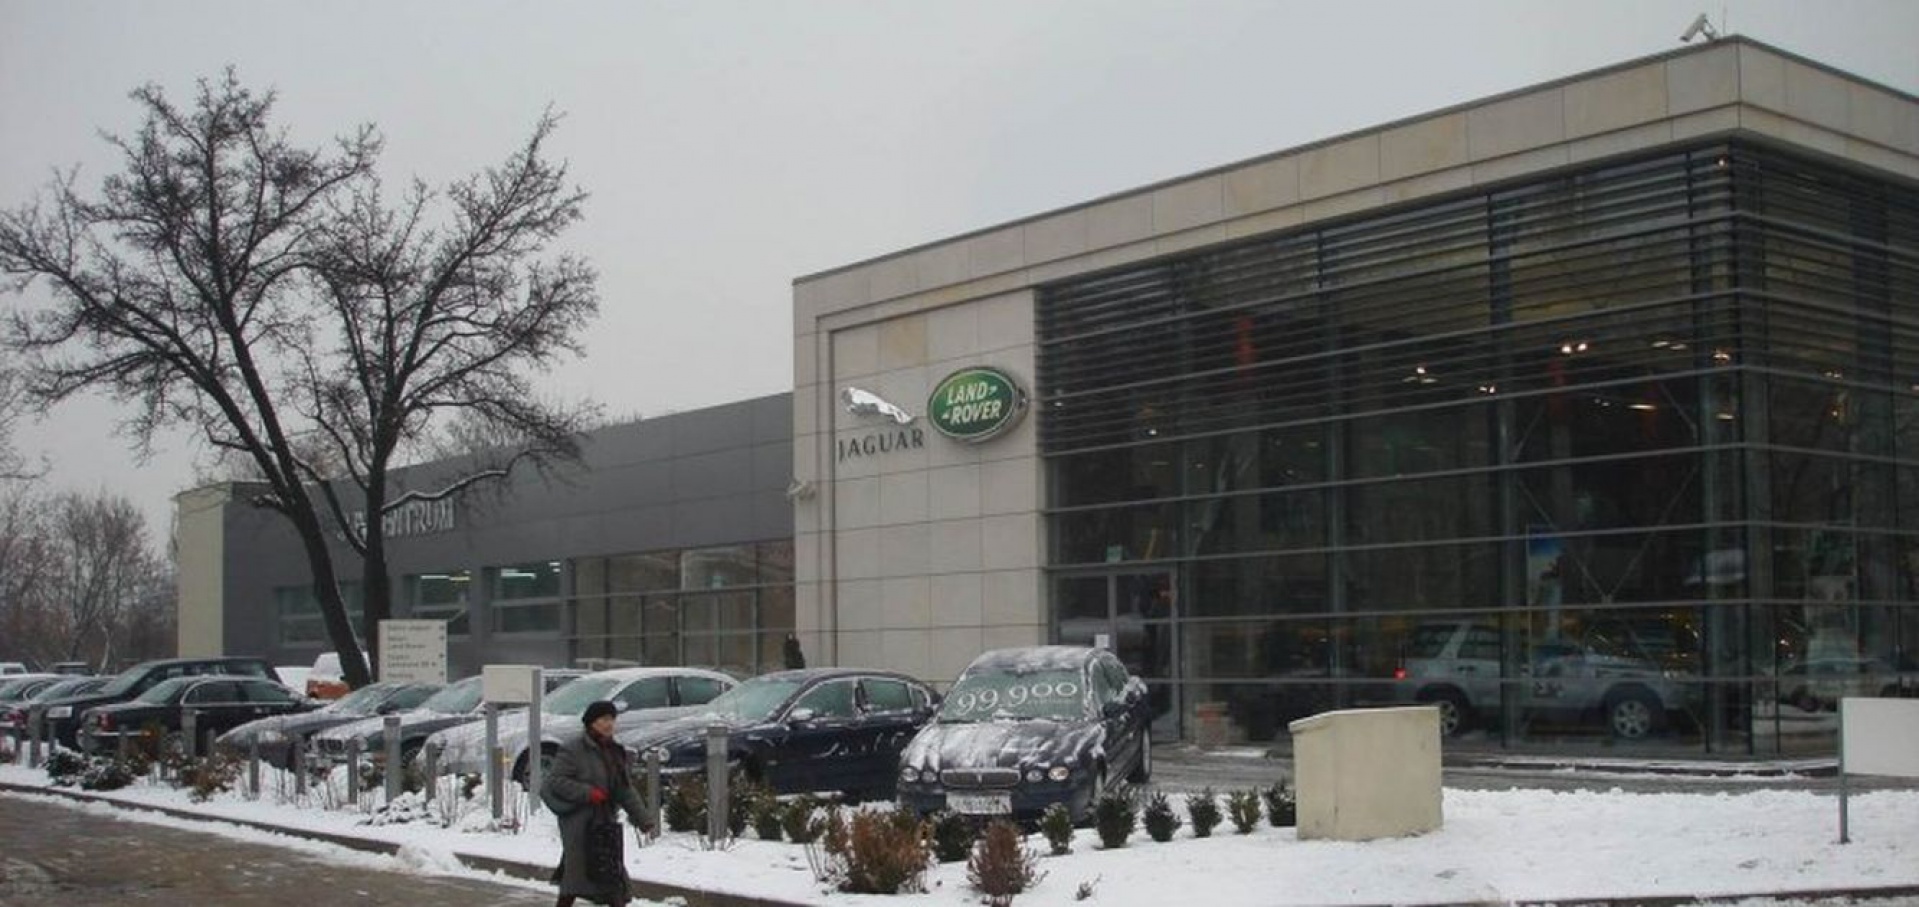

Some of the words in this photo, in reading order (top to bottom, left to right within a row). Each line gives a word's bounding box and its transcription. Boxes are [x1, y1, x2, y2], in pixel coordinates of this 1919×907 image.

[945, 382, 986, 406] LAND
[951, 401, 1002, 425] ROVER
[838, 428, 924, 462] JAGUAR
